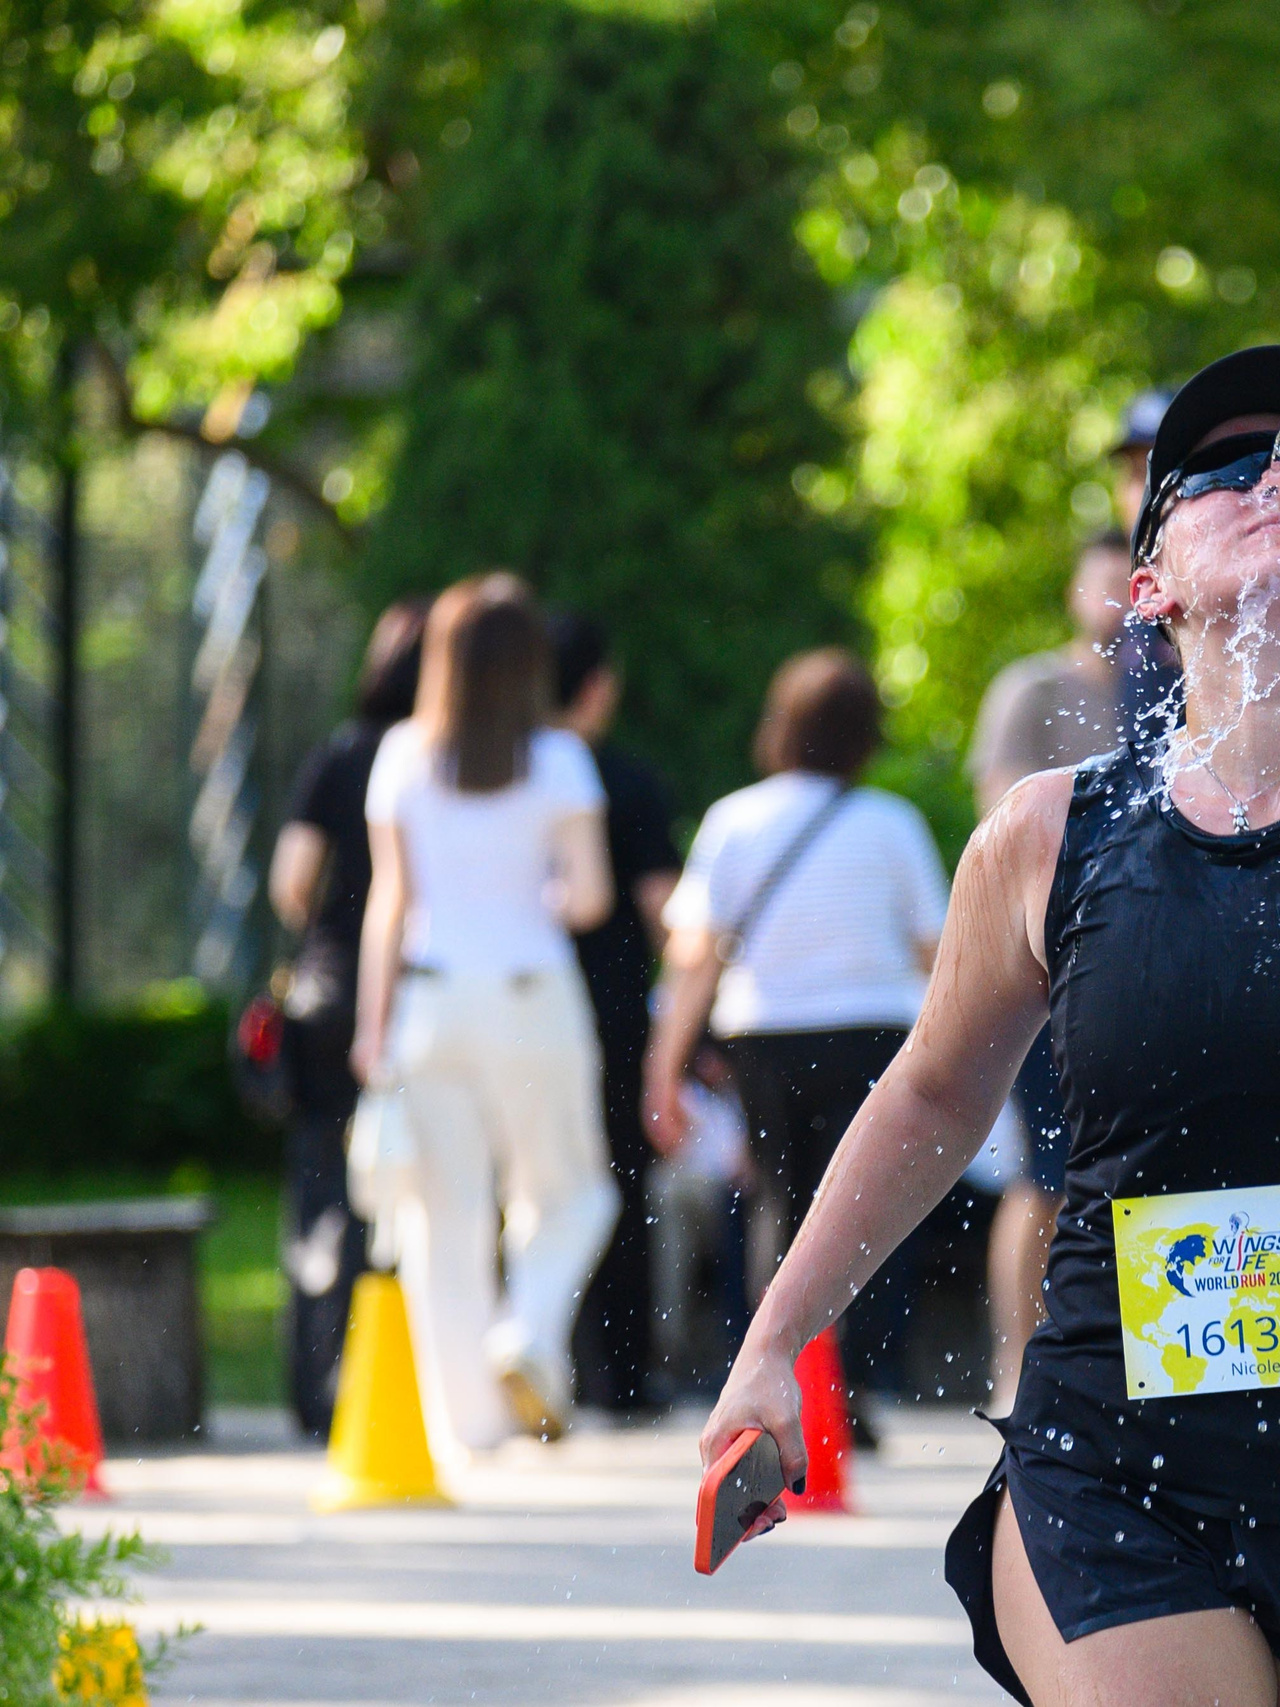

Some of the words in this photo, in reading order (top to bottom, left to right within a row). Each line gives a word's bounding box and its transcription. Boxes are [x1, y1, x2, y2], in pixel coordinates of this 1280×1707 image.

[1208, 1256, 1225, 1265] FOR
[1224, 1252, 1269, 1272] LIFE
[1231, 1359, 1280, 1376] Nicole
